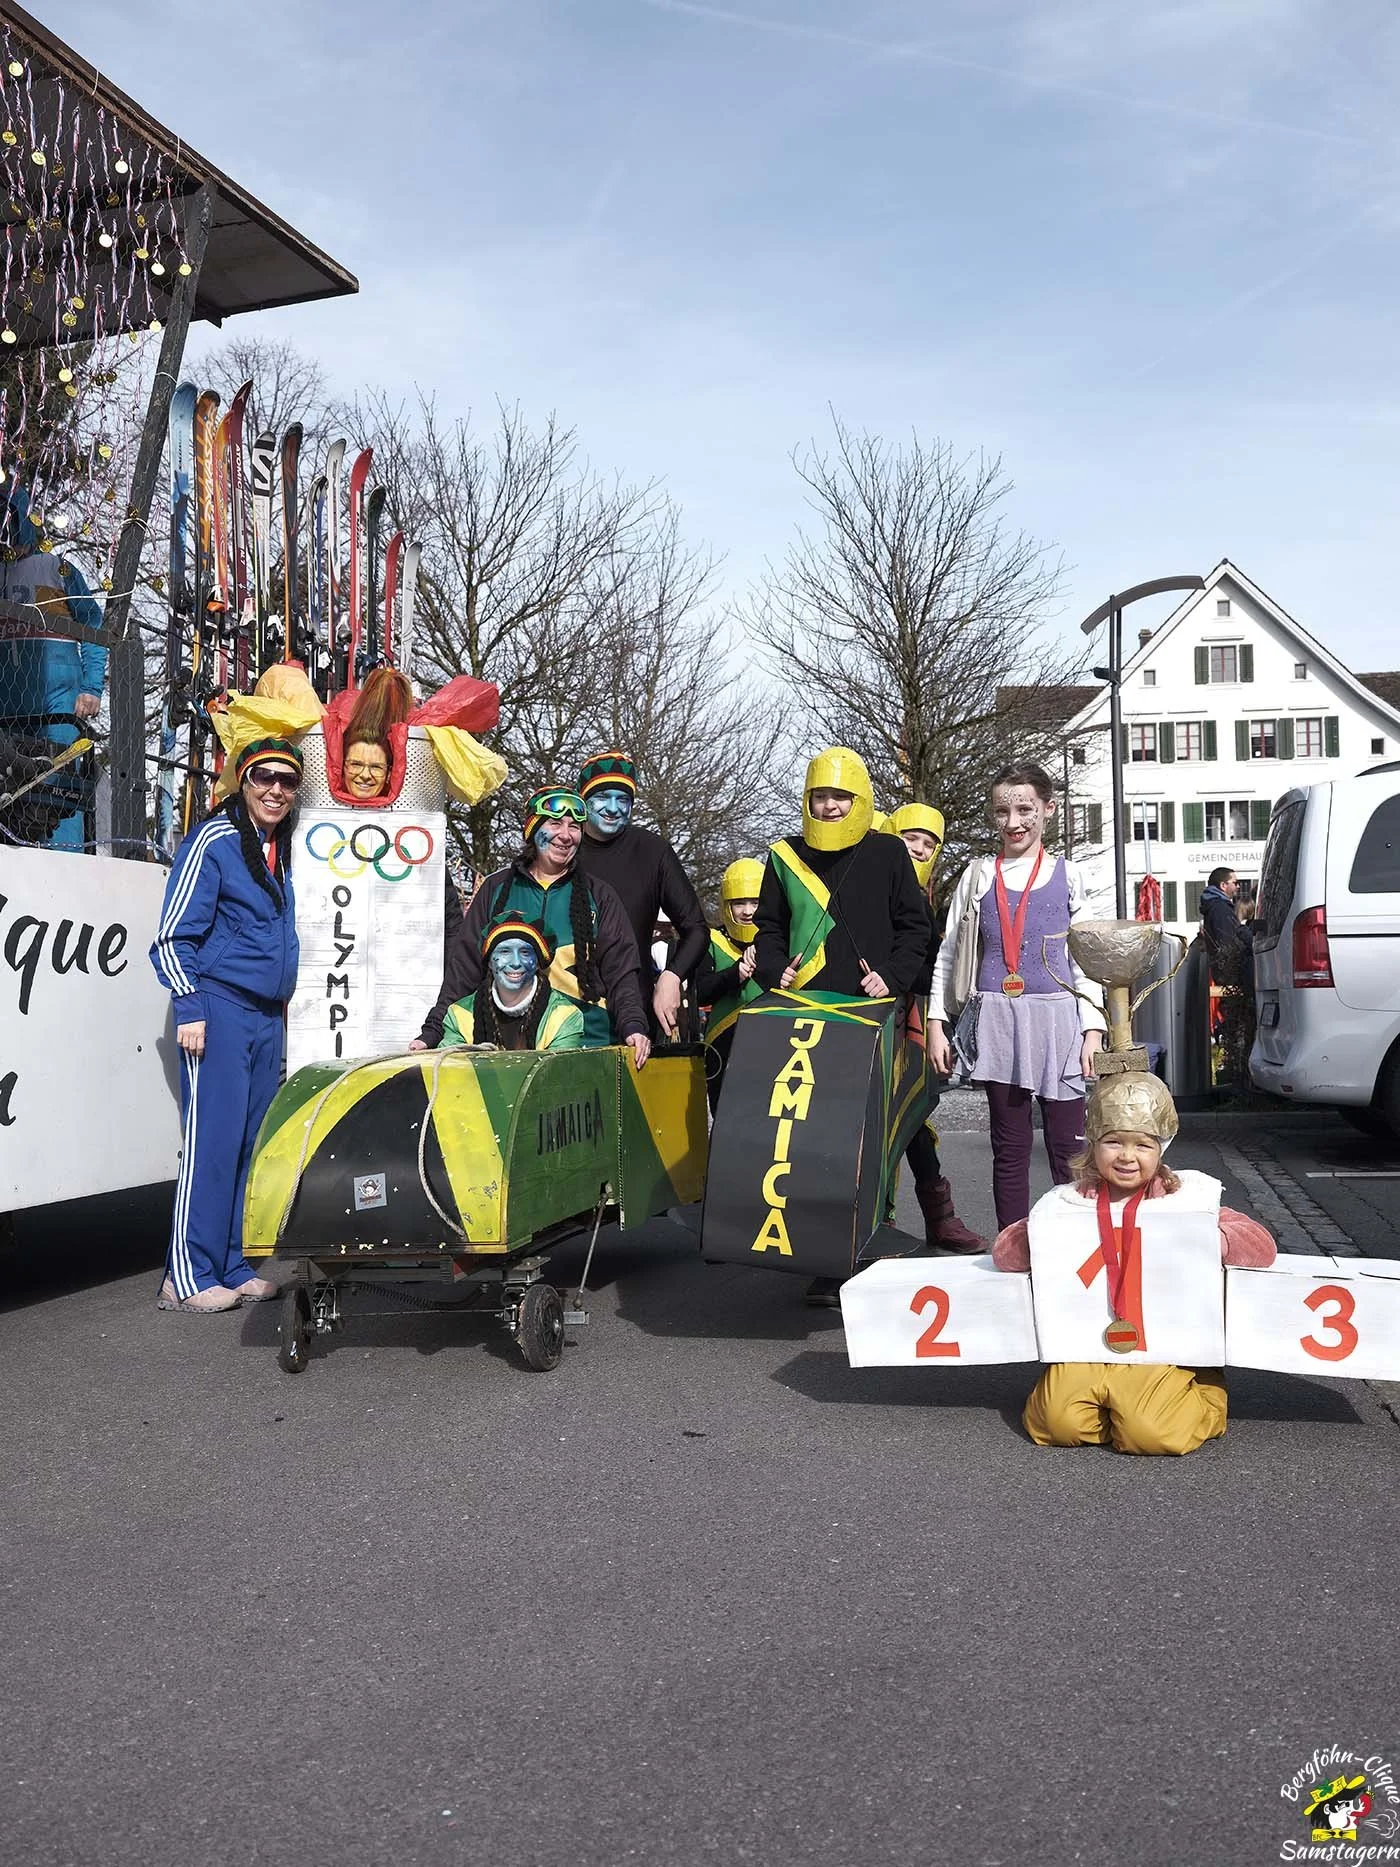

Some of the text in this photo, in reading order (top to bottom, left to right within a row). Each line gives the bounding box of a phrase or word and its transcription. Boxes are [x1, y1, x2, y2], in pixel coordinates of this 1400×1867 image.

[236, 443, 244, 489] ATOMIC
[0, 895, 128, 1015] que
[327, 885, 355, 1058] OLYMPI
[537, 1088, 604, 1156] JAMAICA
[751, 1018, 826, 1256] JAMICA
[910, 1285, 960, 1358] 2
[1076, 1227, 1147, 1352] 1
[1301, 1285, 1359, 1362] 3
